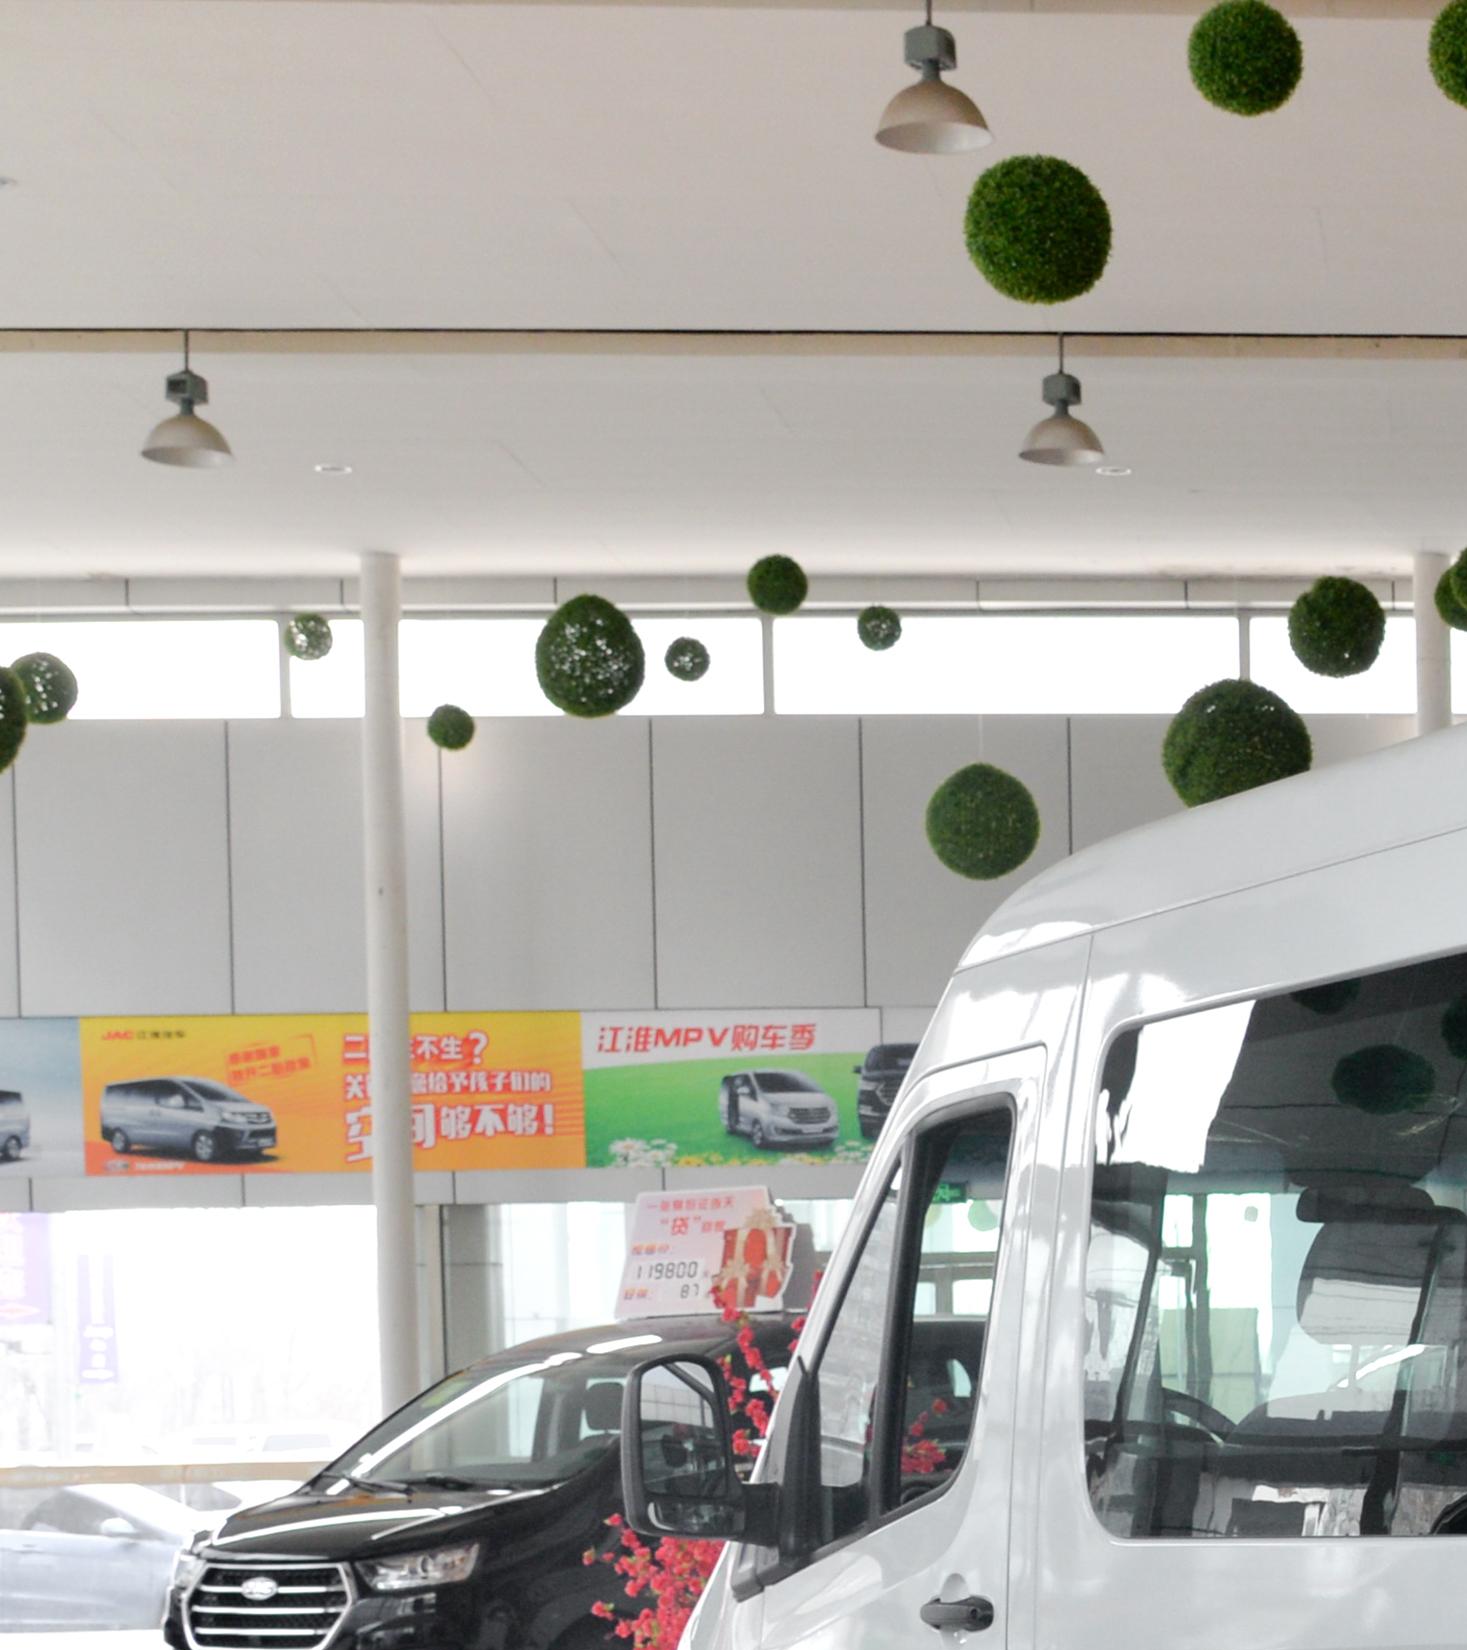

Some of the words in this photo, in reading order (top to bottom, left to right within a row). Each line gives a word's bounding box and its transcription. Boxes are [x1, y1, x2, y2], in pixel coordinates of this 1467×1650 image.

[597, 1023, 816, 1053] 江淮MPV购车季
